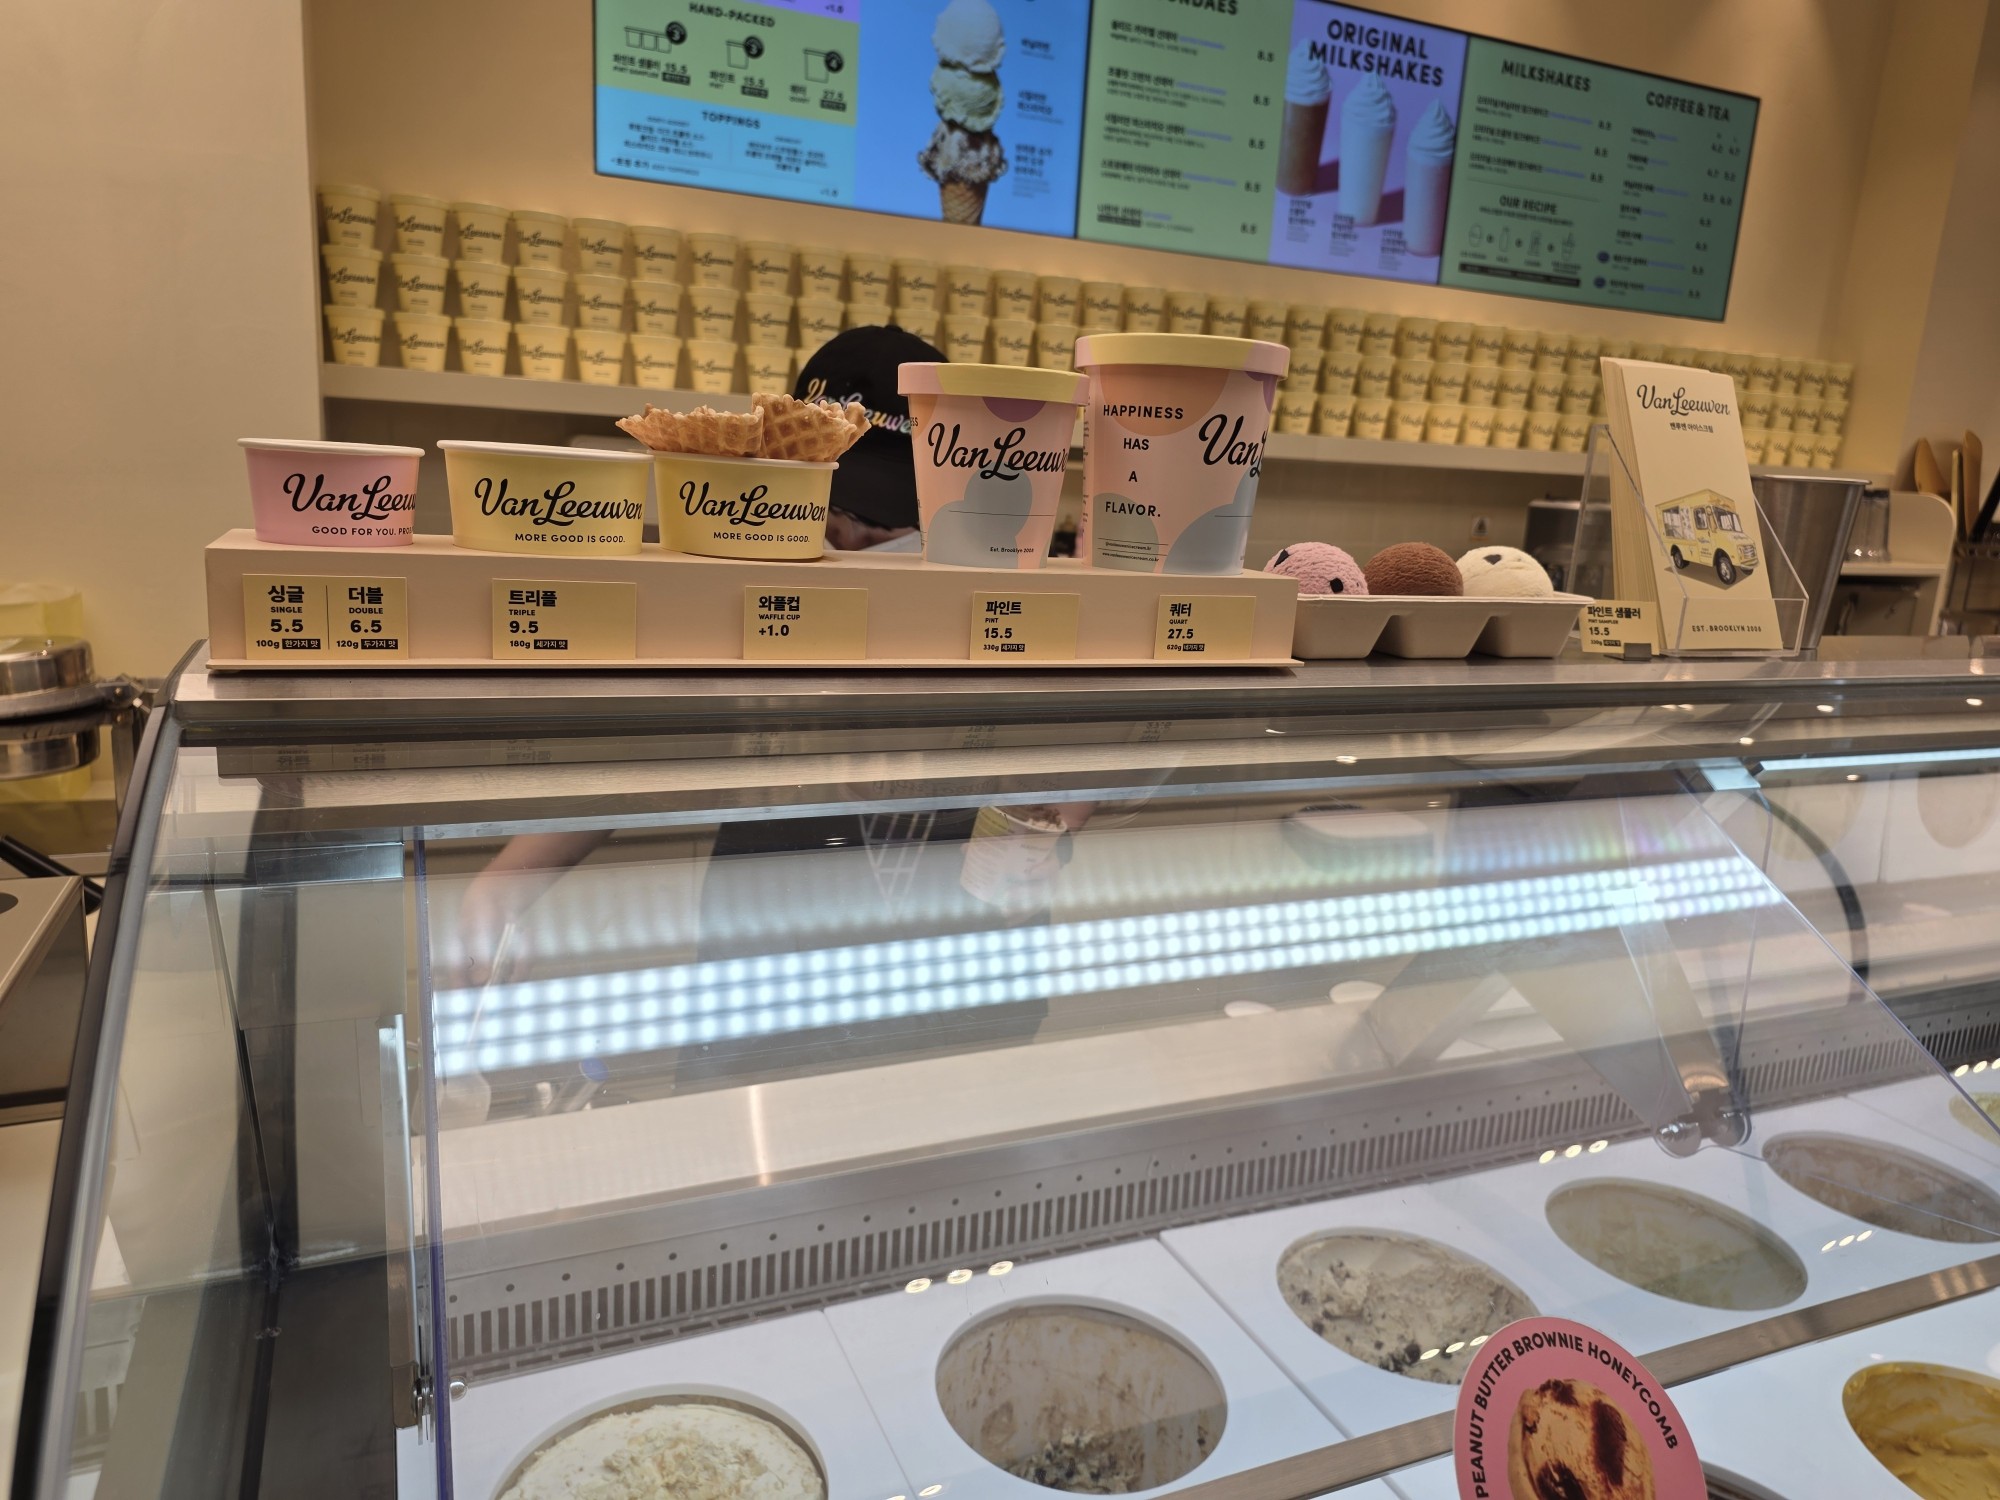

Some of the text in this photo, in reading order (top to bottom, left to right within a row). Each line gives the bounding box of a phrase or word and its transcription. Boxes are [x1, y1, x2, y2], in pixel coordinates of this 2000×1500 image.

[689, 1, 776, 28] HAND-PACKED
[1327, 18, 1428, 59] ORIGINAL
[1308, 40, 1444, 87] MILKSHAKES
[1501, 59, 1591, 92] MILKSHAKES
[1646, 91, 1694, 115] COFFEE
[1708, 103, 1731, 122] TEA
[701, 111, 761, 129] TOPPINGS
[1103, 405, 1184, 420] HAPPINESS
[1123, 437, 1150, 451] HAS
[1128, 471, 1138, 483] A
[1105, 501, 1161, 517] FLAVOR.
[312, 525, 348, 536] GOOD
[352, 527, 372, 536] FOR
[375, 528, 397, 536] YOU.
[713, 532, 742, 540] MORE
[745, 533, 774, 542] GOOD
[788, 535, 810, 543] GOOD.
[515, 533, 627, 543] MORE GOOD IS GOOD.
[268, 585, 305, 604] 싱글
[348, 586, 384, 605] 더블
[508, 590, 558, 607] 트리플
[270, 606, 303, 614] SINGLE
[758, 595, 800, 611] 와플컵
[985, 600, 1022, 616] 파인트
[1169, 602, 1192, 617] 쿼터
[348, 607, 384, 615] DOUBLE
[1587, 605, 1641, 620] 파인트 샘플러
[270, 619, 304, 633] 5.5
[350, 619, 383, 633] 6.5
[509, 620, 539, 634] 9.5
[758, 624, 790, 636] +1.0
[984, 627, 1013, 639] 15.5
[1588, 626, 1610, 636] 15.5
[1691, 625, 1709, 633] EST.
[1709, 625, 1745, 633] BROOKLYN
[1167, 628, 1194, 640] 27.5
[256, 640, 319, 649] 100g 한가지 맛
[336, 640, 396, 650] 120g 두가지 맛
[509, 640, 531, 649] 180g
[1469, 1331, 1679, 1499] PEANUT BUTTER BROWNIE HONEYCOMB
